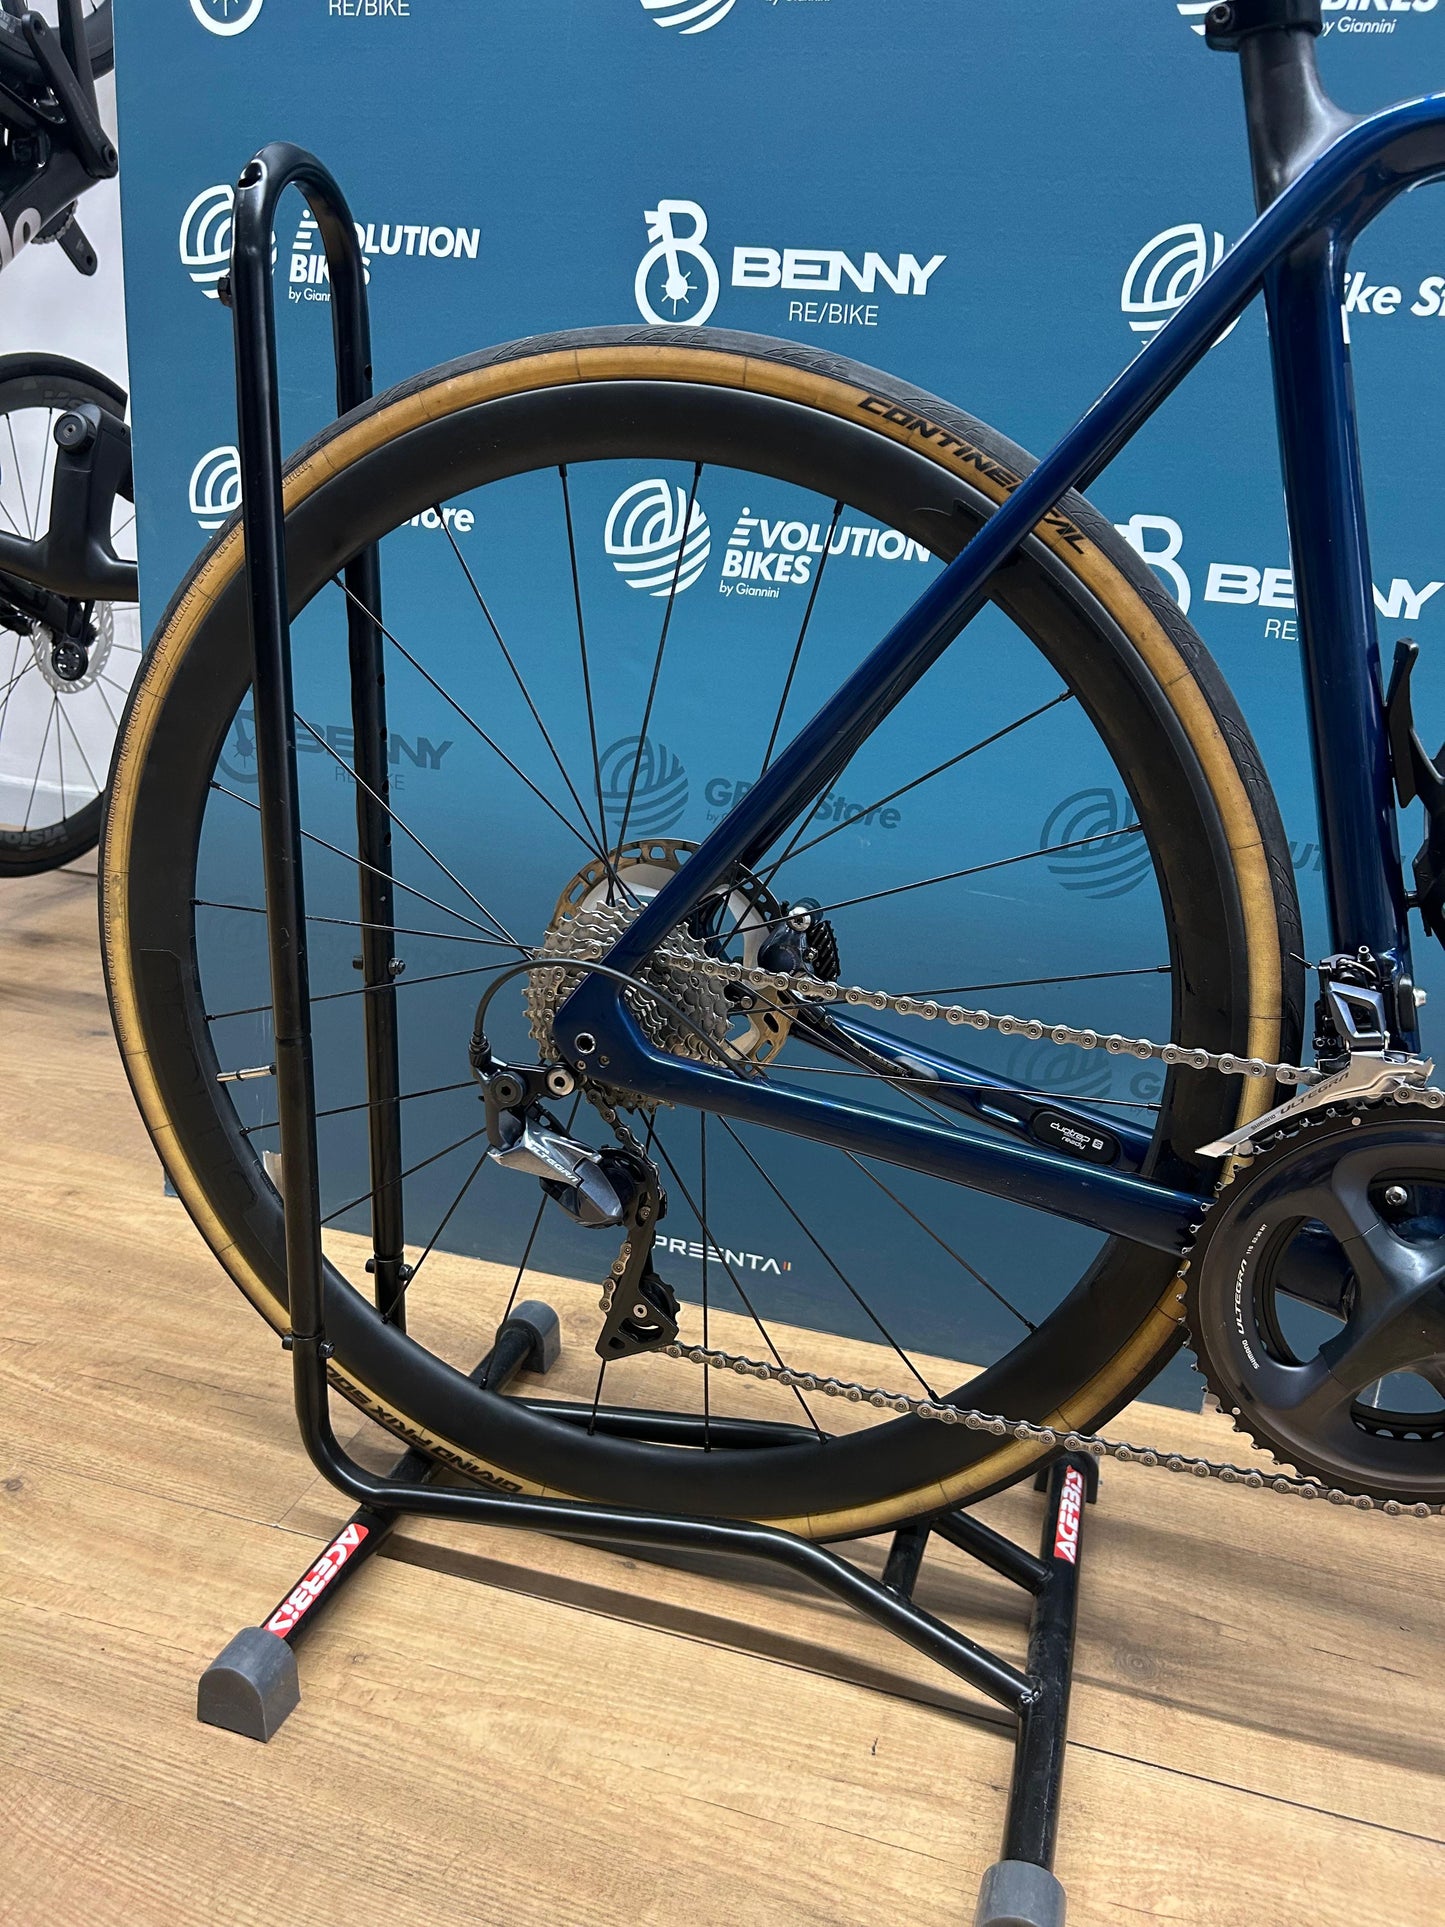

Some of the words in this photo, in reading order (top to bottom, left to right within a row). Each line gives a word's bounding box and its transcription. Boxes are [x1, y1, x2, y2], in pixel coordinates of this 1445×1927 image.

[329, 0, 410, 16] RE/BIKE
[1338, 16, 1397, 33] Giannini
[731, 246, 947, 296] BENNY
[288, 286, 302, 304] by
[788, 301, 879, 326] RE/BIKE
[721, 549, 813, 585] BIKES
[719, 580, 735, 598] by
[736, 582, 781, 598] Giannini
[814, 791, 902, 830] Store
[1280, 1071, 1350, 1115] ULTEGRA
[1234, 1258, 1248, 1335] ULTEGRA
[1241, 1339, 1260, 1371] SHIMANO
[369, 1404, 433, 1447] PRIX
[430, 1445, 524, 1493] GRAND
[1055, 1470, 1084, 1565] ACERBIS
[267, 1523, 360, 1632] ACERBIS
